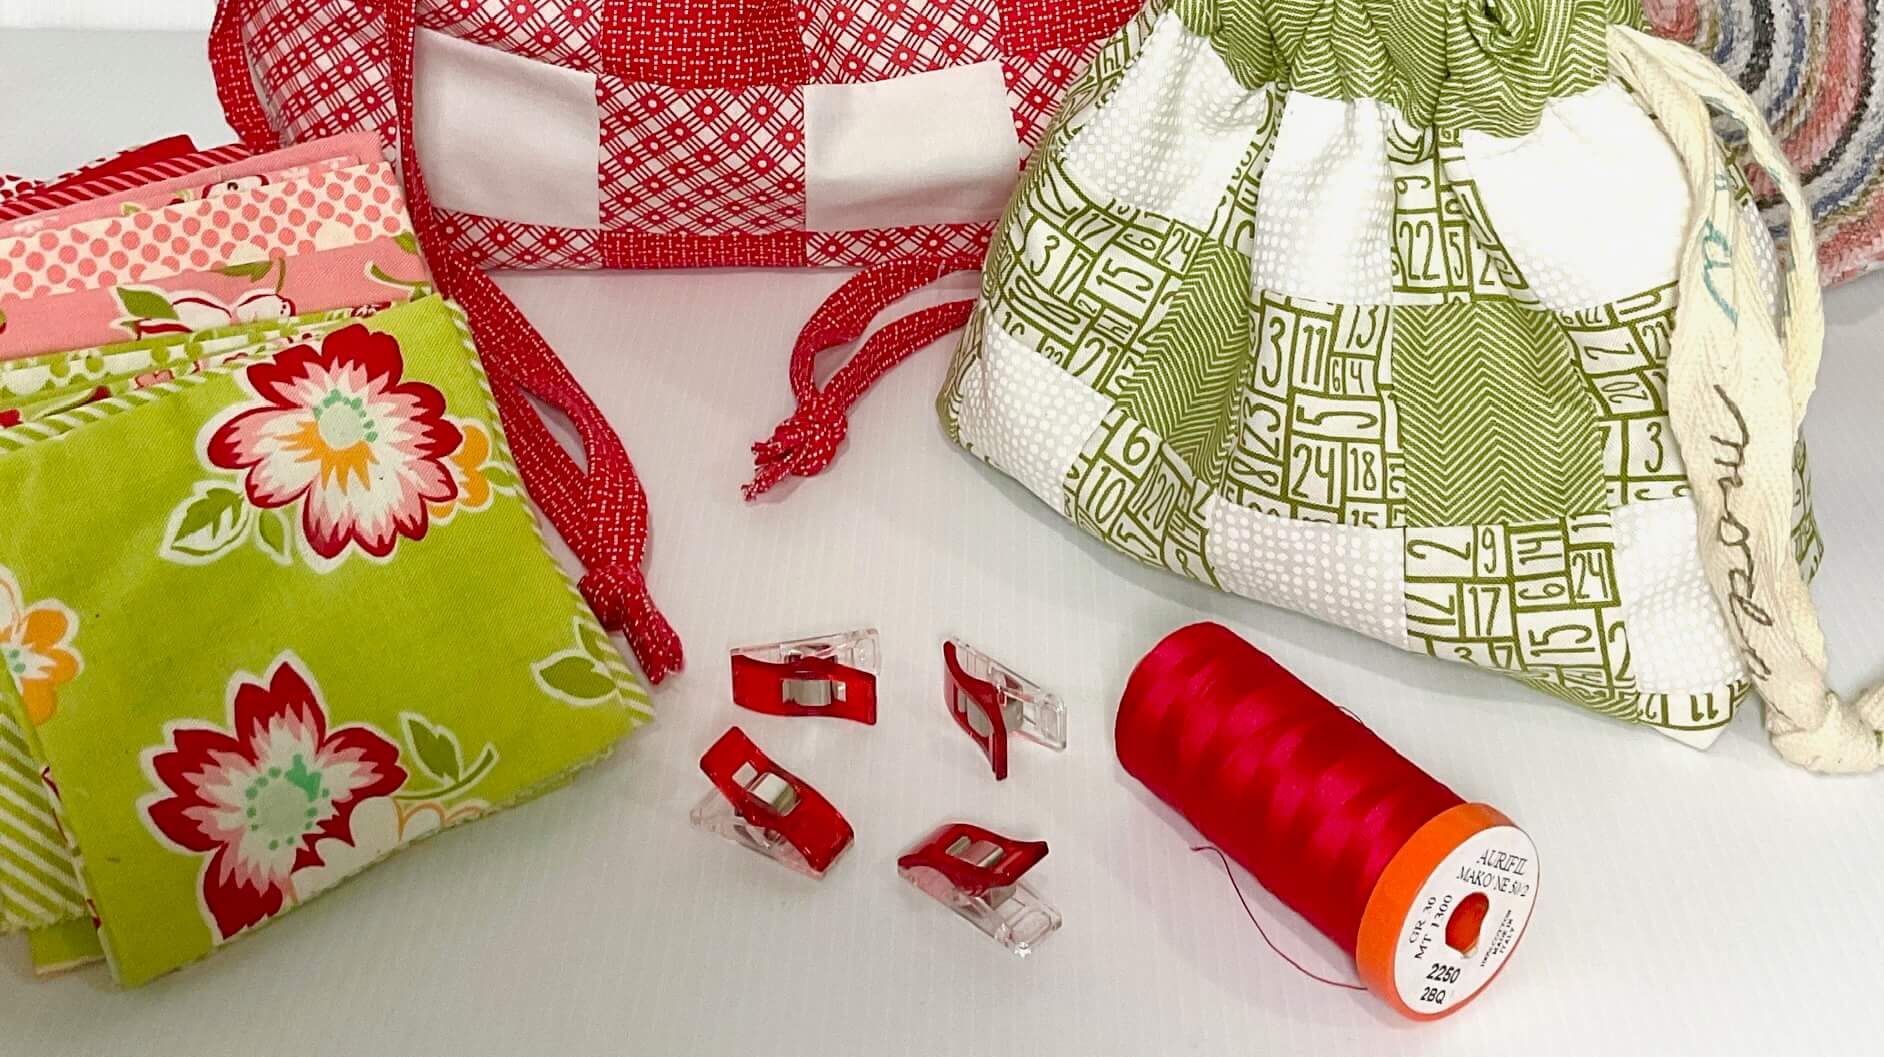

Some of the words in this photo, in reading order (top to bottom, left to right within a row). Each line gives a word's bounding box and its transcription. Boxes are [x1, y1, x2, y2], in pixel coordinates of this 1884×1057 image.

[1029, 234, 1060, 276] 3
[1400, 220, 1440, 280] 22
[1261, 316, 1286, 388] 3
[1301, 324, 1328, 386] 11
[1350, 447, 1377, 492] 18
[1644, 421, 1664, 473] 3
[1290, 444, 1335, 505] 24
[1572, 551, 1609, 599] 24
[1469, 586, 1501, 636] 17
[1476, 848, 1528, 876] AURIFIL
[1414, 933, 1432, 960] MT
[1420, 986, 1447, 1005] 2BQ
[1426, 962, 1462, 984] 2250
